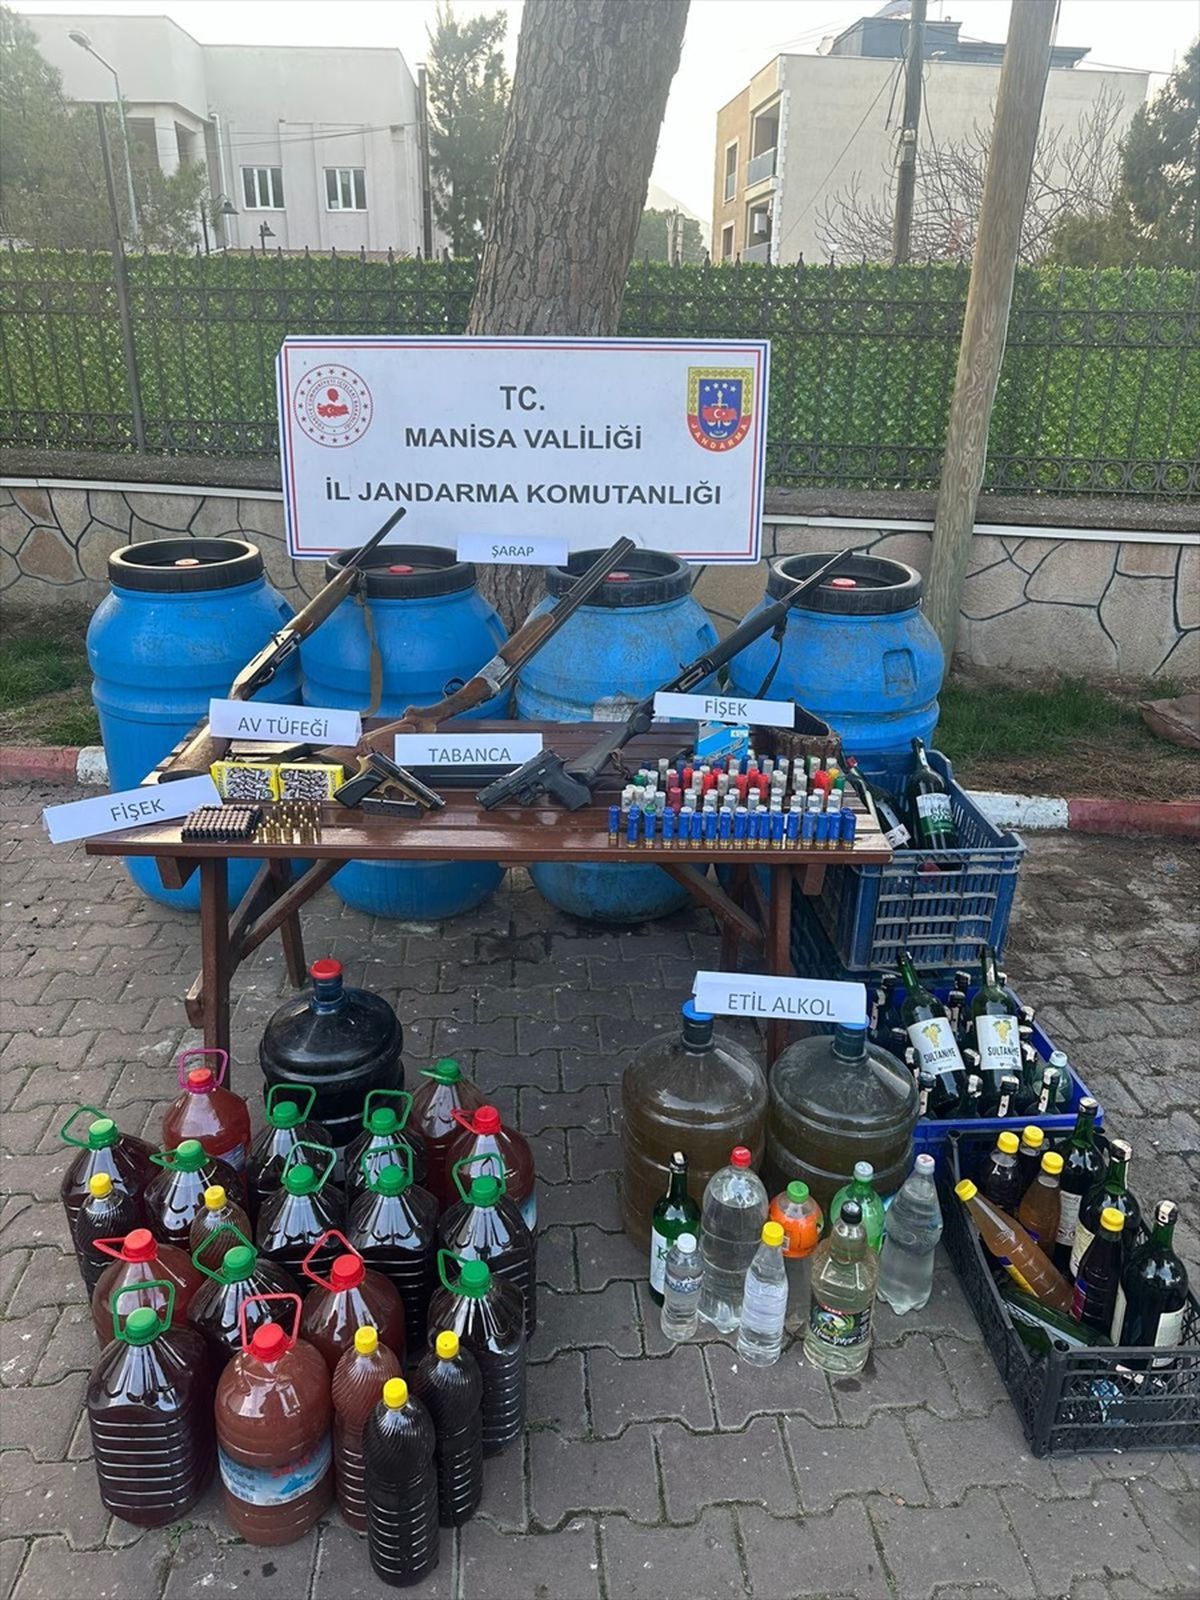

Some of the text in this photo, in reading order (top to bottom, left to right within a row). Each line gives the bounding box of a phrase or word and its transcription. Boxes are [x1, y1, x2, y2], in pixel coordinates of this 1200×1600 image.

[500, 386, 545, 411] TC.
[405, 424, 642, 450] MANİSA VALİLİĞİ
[691, 423, 748, 450] JANDARMA
[326, 476, 721, 505] İL JANDARMA KOMUTANLIĞI
[491, 545, 535, 558] ŞARAP
[704, 698, 748, 719] FİŞEK
[238, 716, 328, 738] AV TÜFEĞİ
[428, 747, 512, 764] TABANCA
[110, 797, 166, 823] FİŞEK
[728, 991, 836, 1017] ETİL ALKOL
